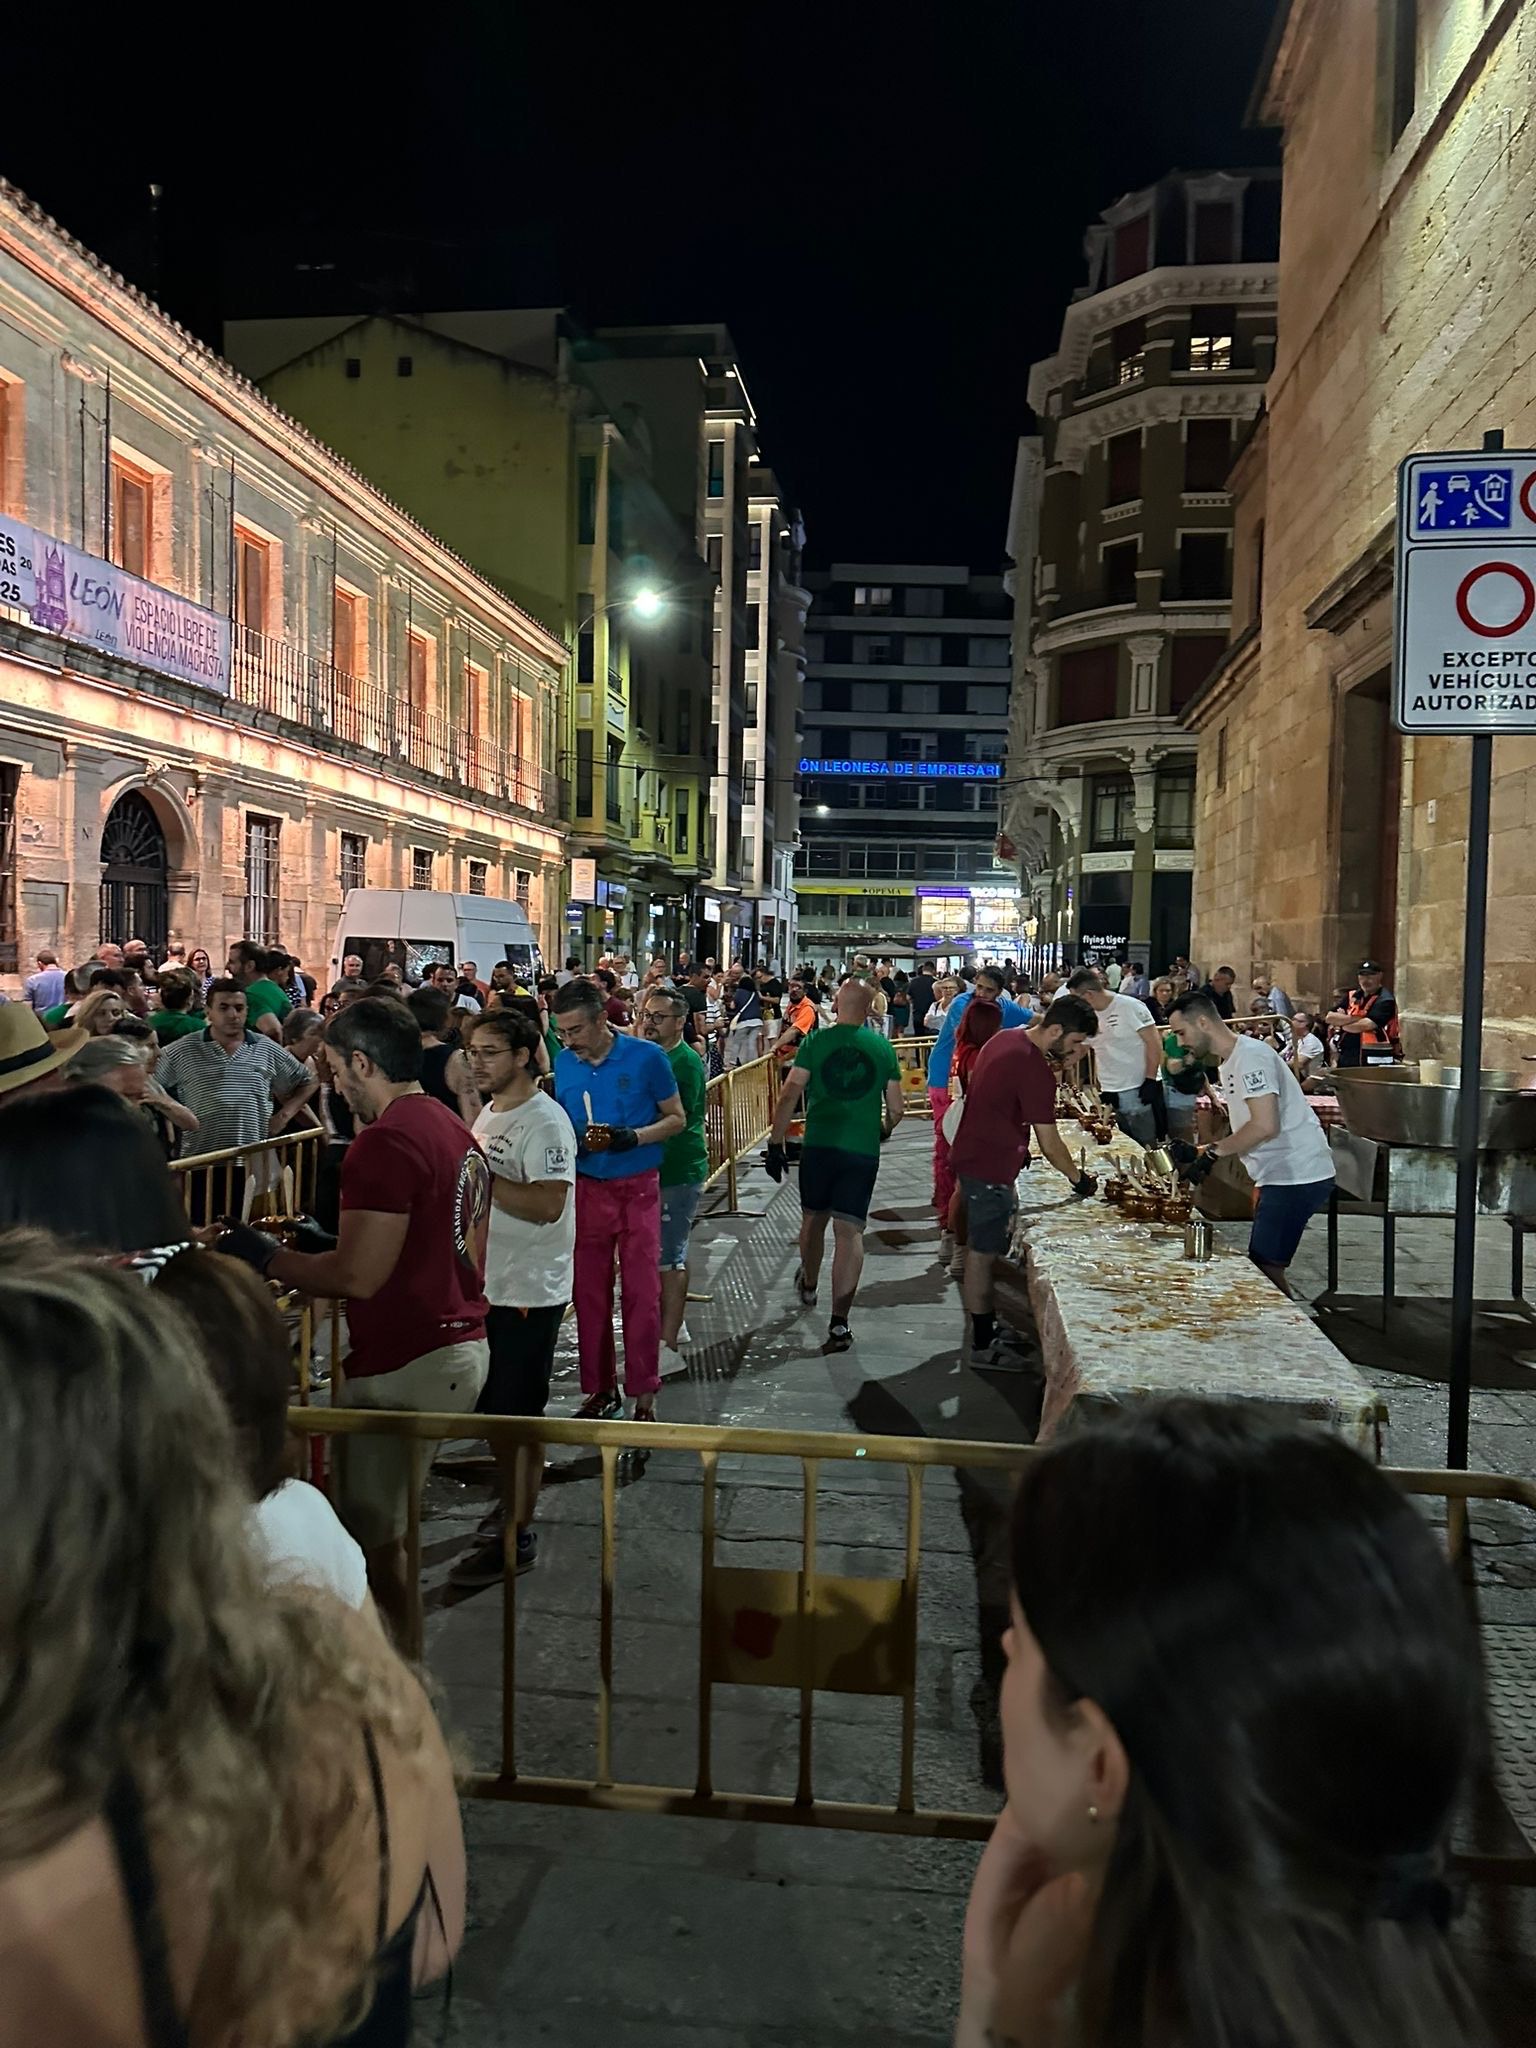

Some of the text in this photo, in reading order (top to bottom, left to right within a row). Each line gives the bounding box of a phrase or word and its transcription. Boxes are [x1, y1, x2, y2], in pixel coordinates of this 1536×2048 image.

[0, 558, 17, 577] AS
[20, 556, 32, 571] 20
[0, 580, 20, 602] 25
[135, 596, 218, 652] ESPACIO LIBRE DE
[125, 621, 224, 680] VIOLENCIA MACHISTA
[1411, 694, 1536, 711] AUTORIZAD
[824, 761, 889, 774] LEONESA
[894, 763, 914, 774] DE
[919, 764, 1000, 776] EMPRESARI
[1082, 934, 1127, 946] flying tiger
